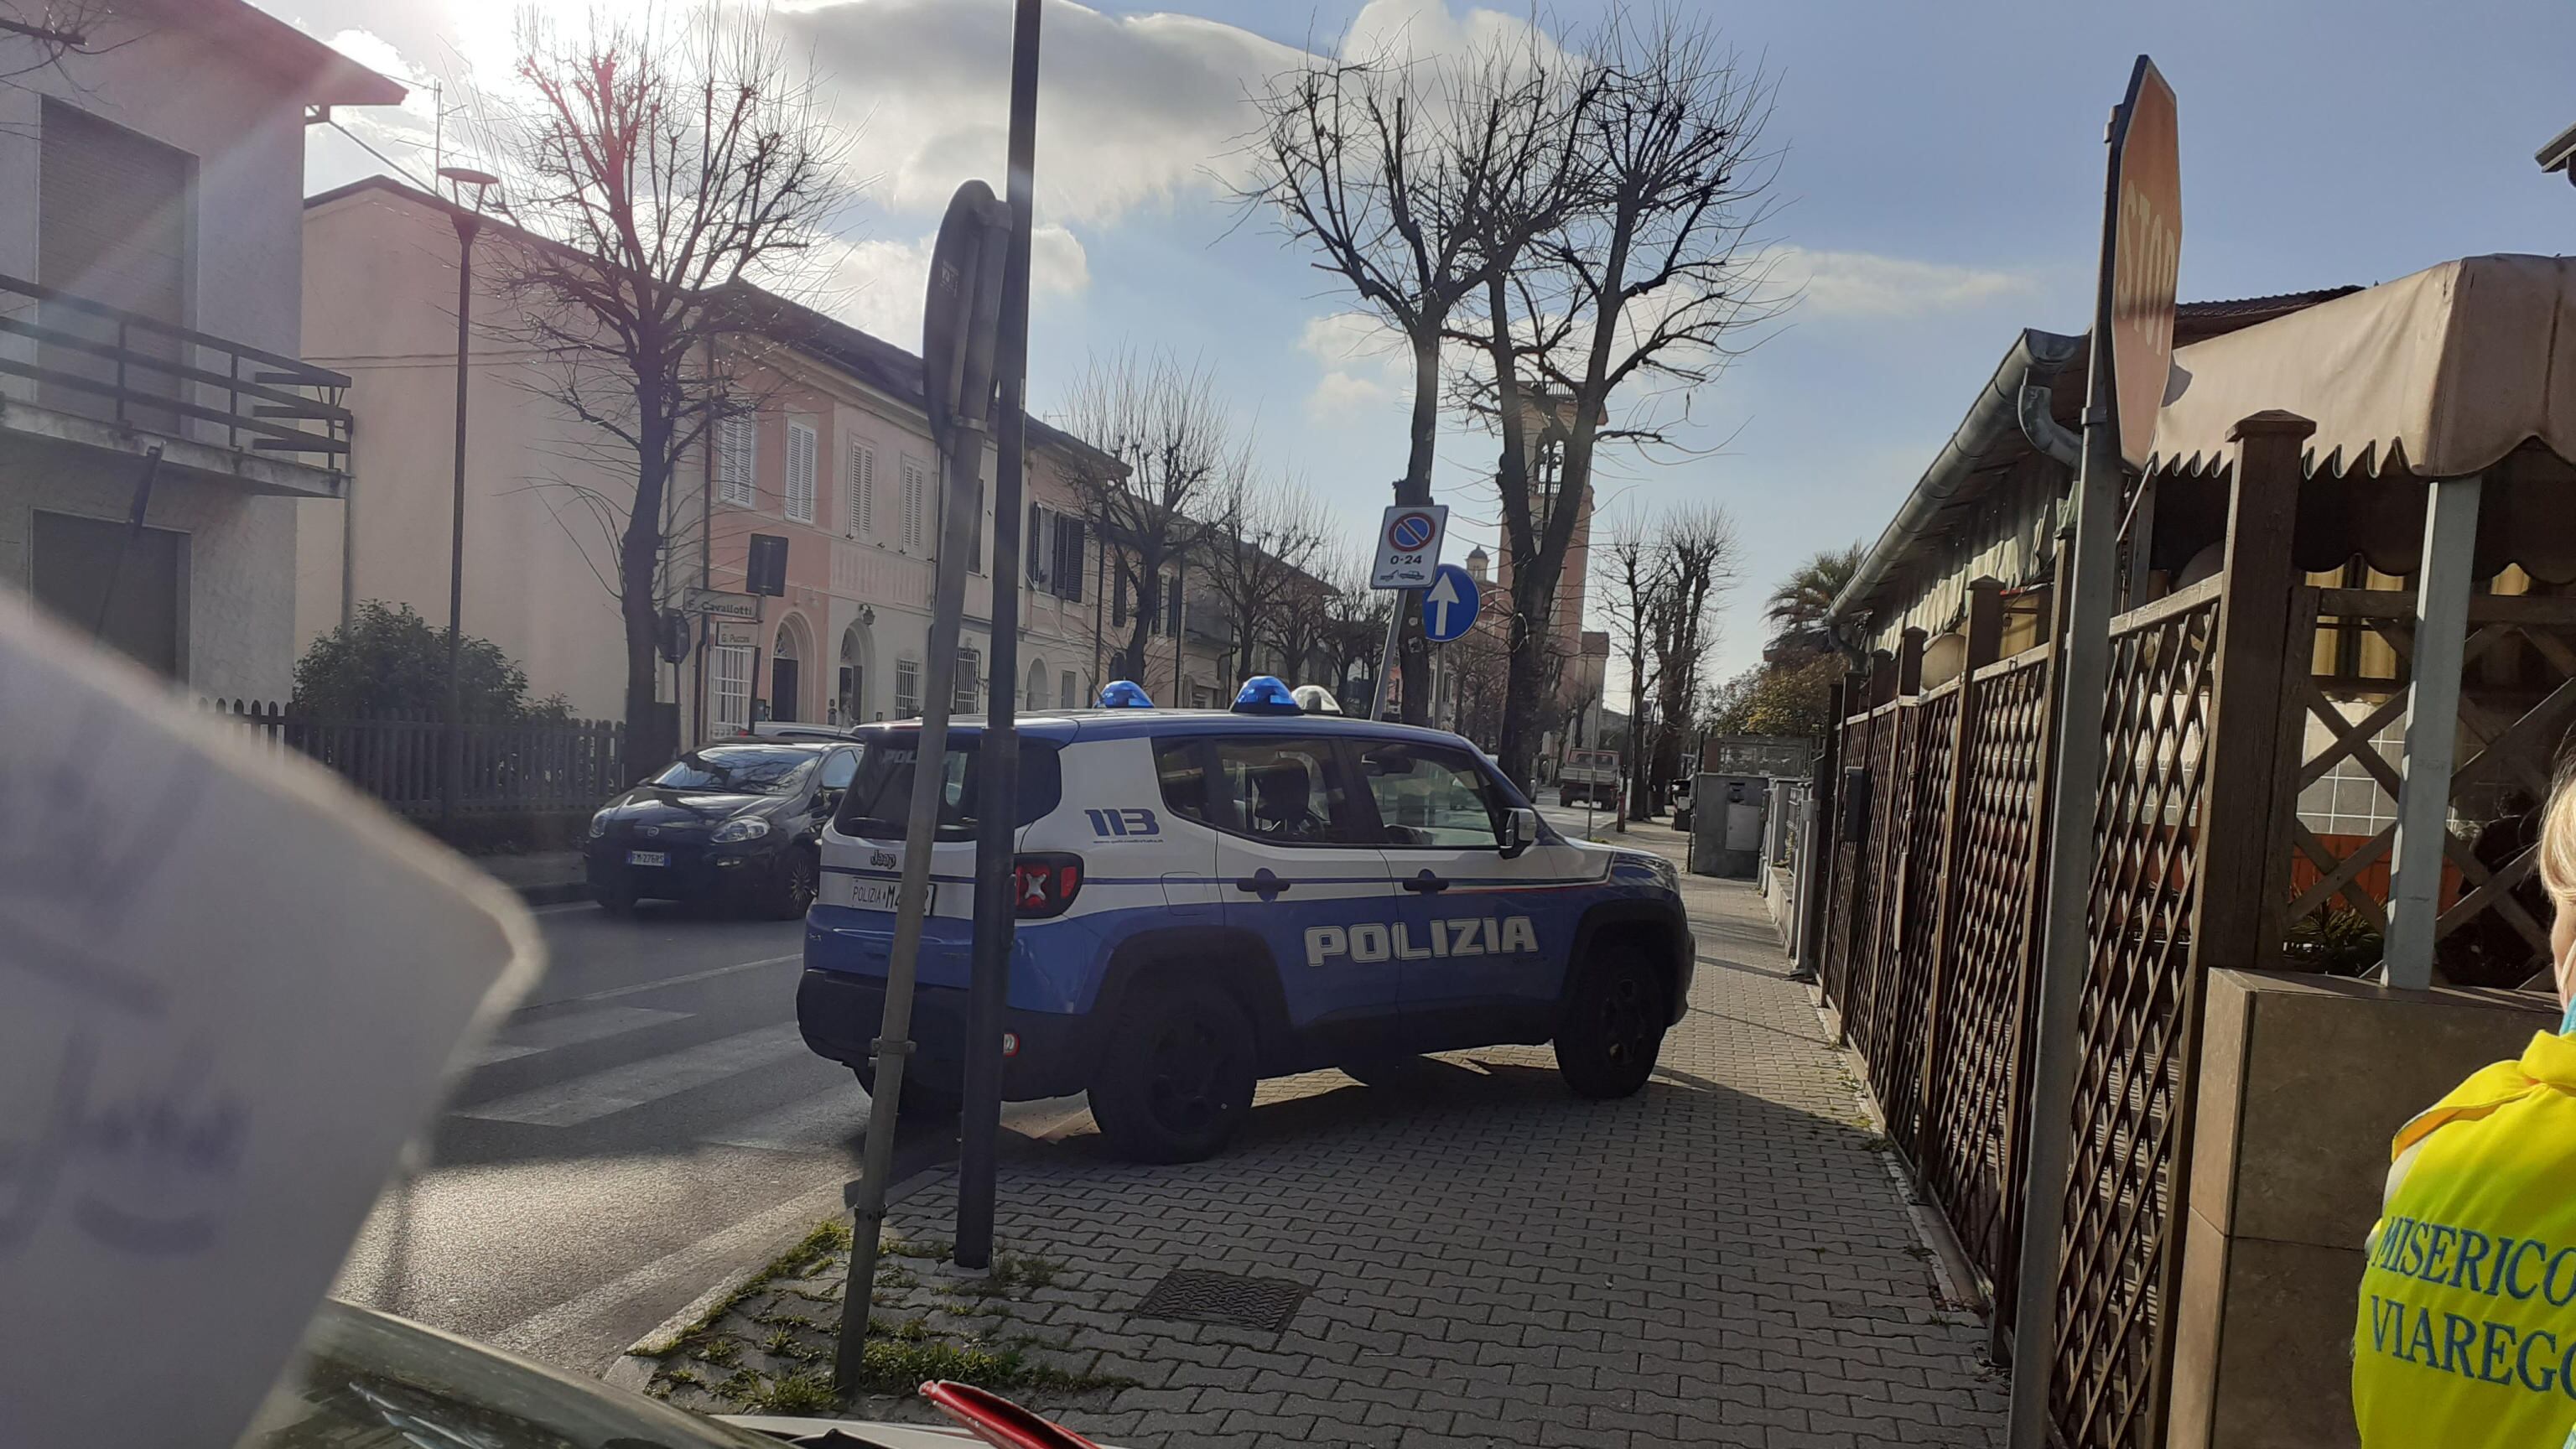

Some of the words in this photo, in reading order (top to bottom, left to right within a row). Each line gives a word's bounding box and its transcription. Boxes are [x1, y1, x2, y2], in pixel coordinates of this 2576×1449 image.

[2117, 179, 2175, 357] STOP
[701, 601, 752, 615] Cavallotti
[1083, 808, 1161, 836] 113
[870, 849, 896, 870] Jeep
[852, 886, 881, 903] POLIZIA
[1304, 916, 1540, 967] POLIZIA
[2371, 1216, 2576, 1308] MISERICO
